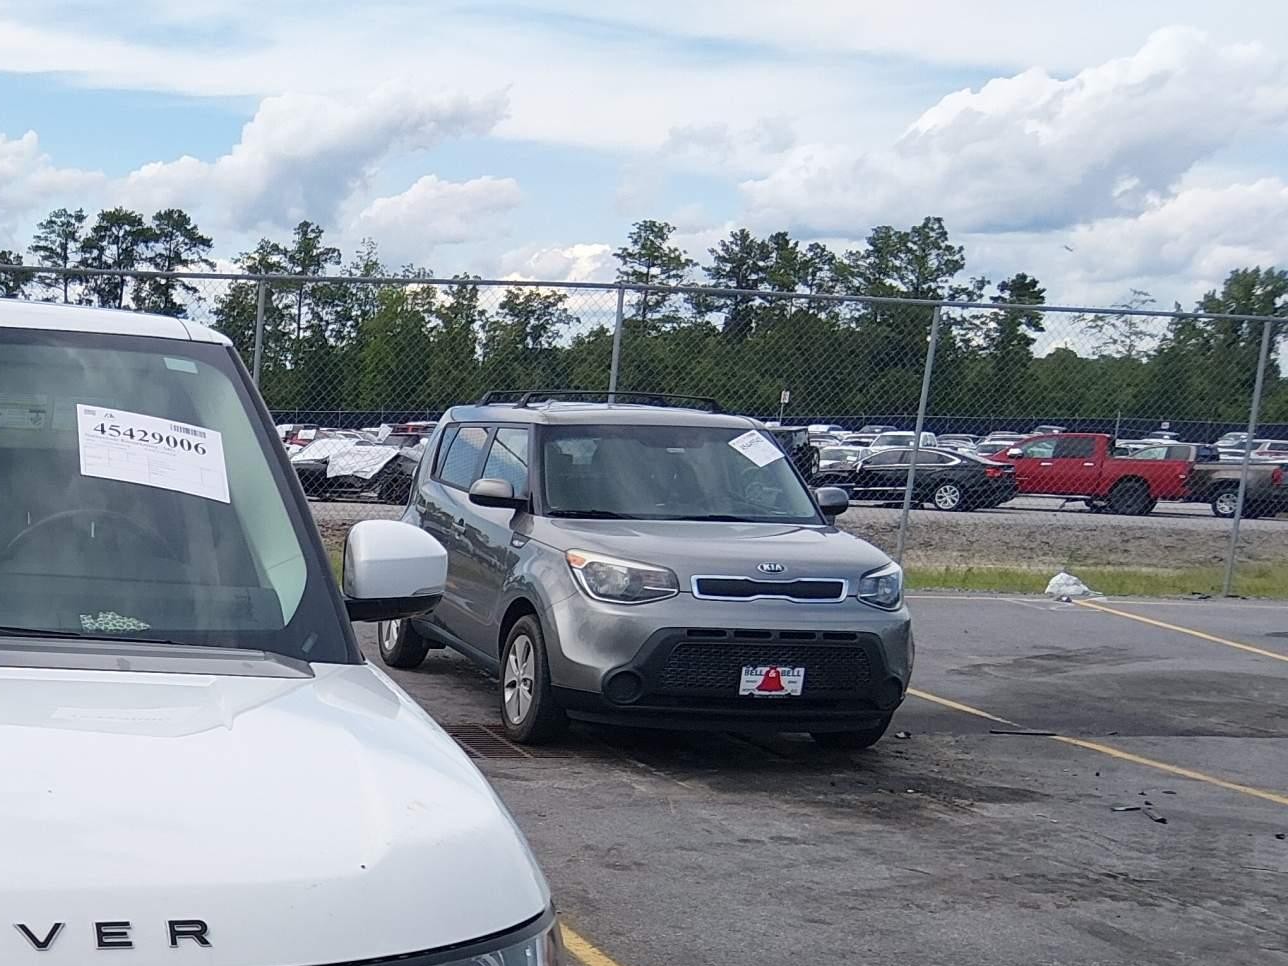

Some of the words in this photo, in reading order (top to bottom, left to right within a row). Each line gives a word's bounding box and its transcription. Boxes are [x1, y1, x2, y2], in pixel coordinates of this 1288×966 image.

[93, 423, 207, 456] 45429006
[744, 669, 764, 677] BELL
[768, 669, 776, 678] &
[780, 669, 801, 677] BELL
